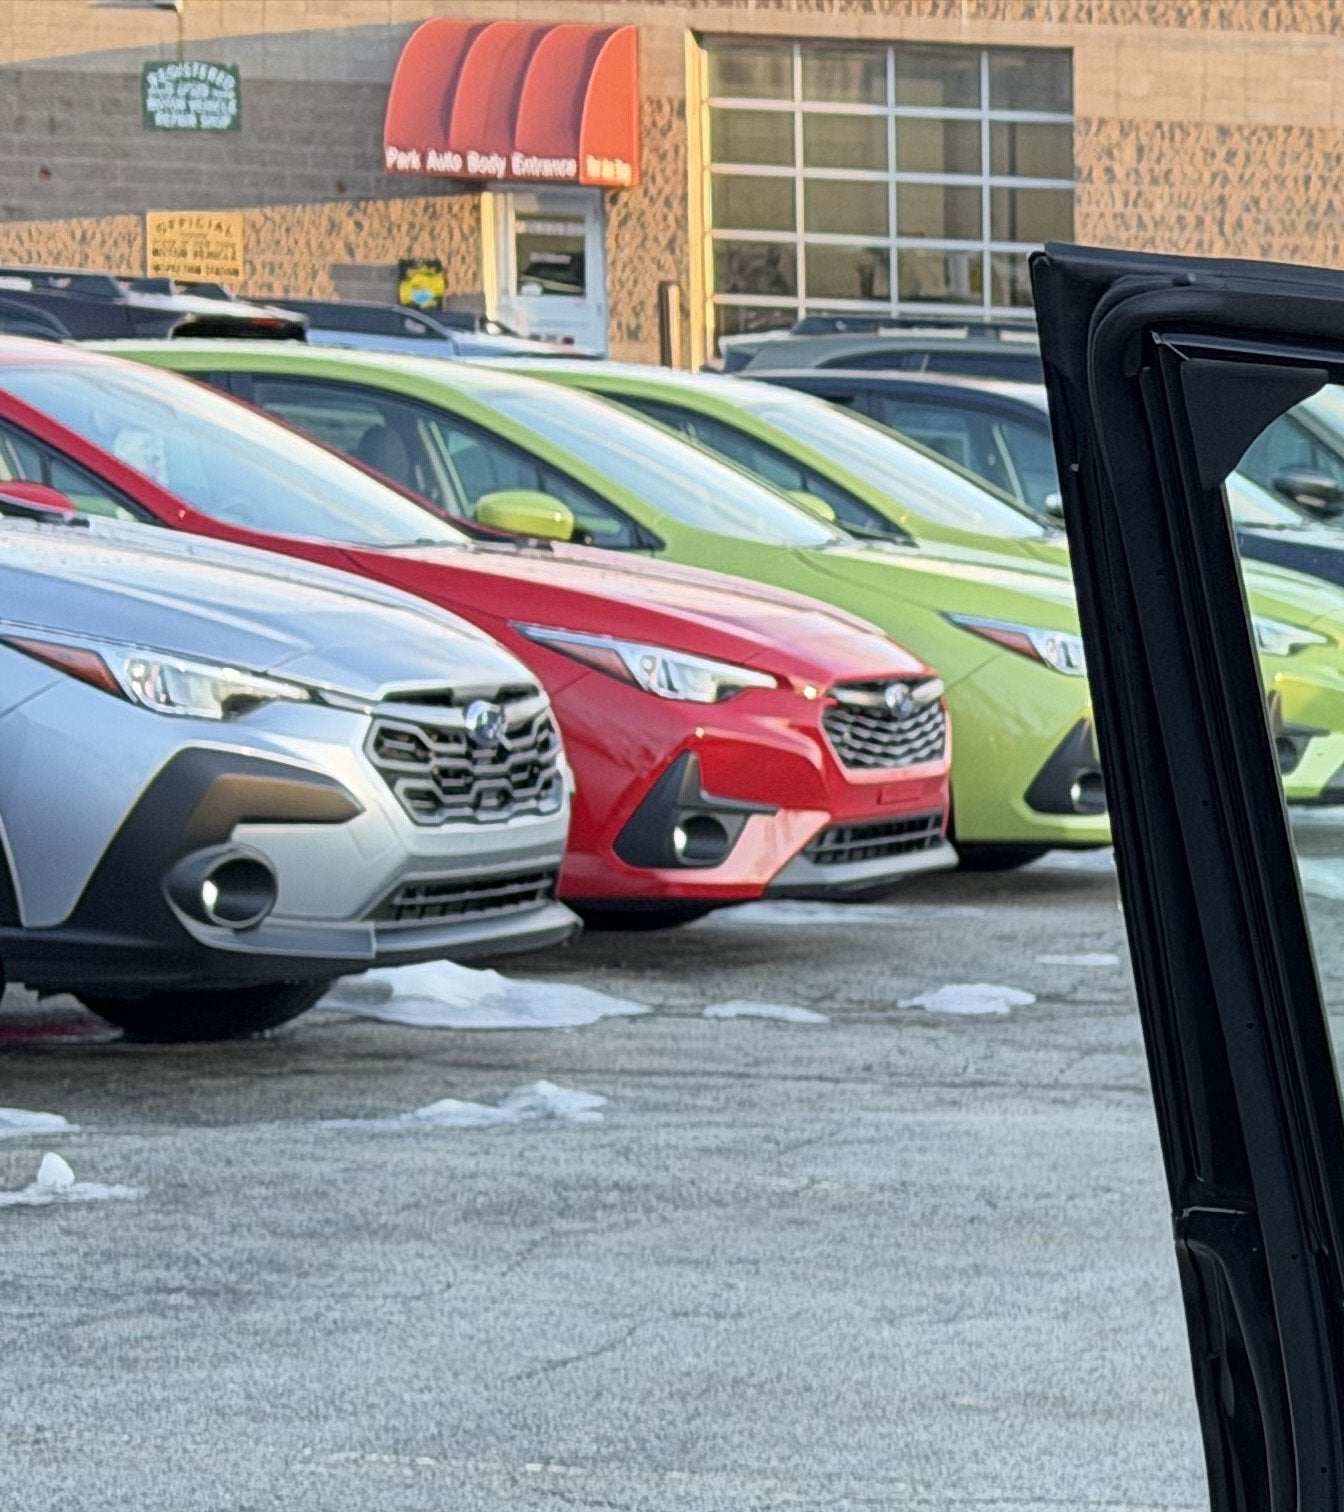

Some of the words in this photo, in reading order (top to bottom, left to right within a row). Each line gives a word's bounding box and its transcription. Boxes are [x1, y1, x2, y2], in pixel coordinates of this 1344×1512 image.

[385, 146, 422, 171] Park
[427, 148, 462, 173] Auto
[467, 150, 507, 179] Body
[512, 151, 577, 177] Entrance
